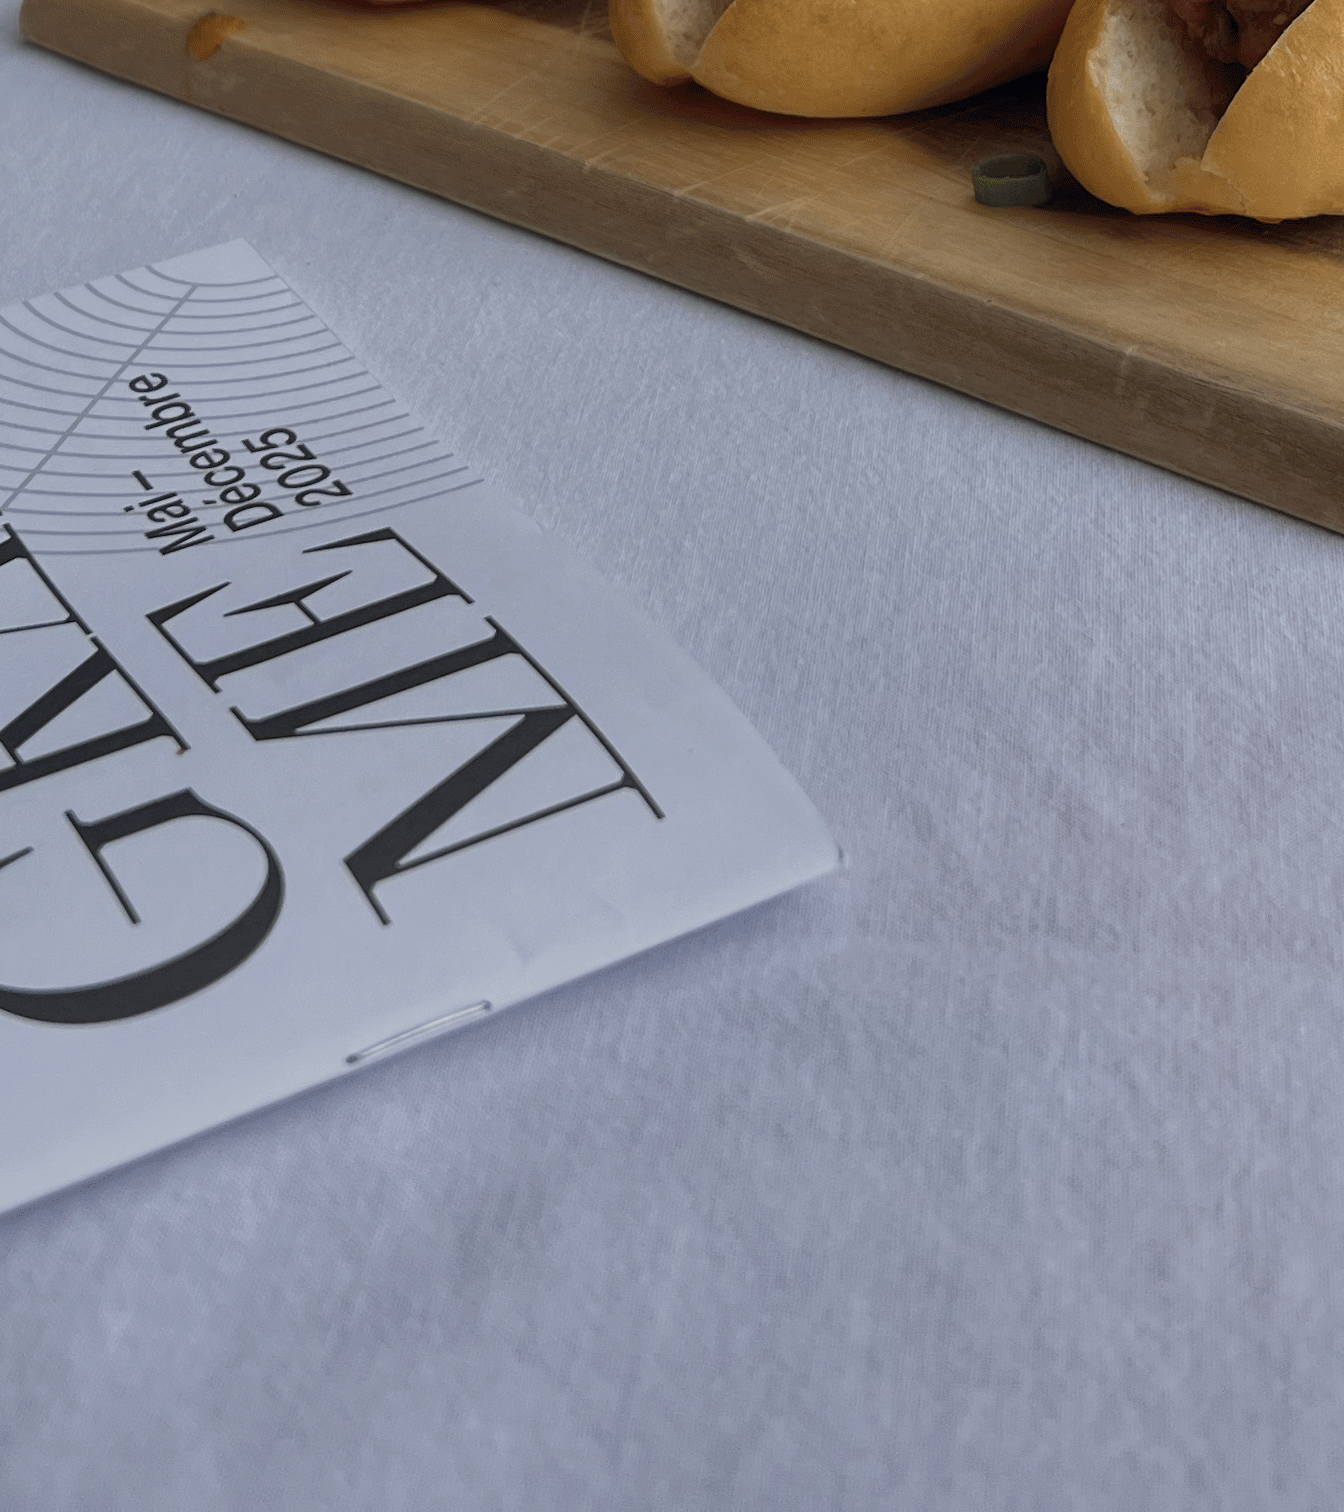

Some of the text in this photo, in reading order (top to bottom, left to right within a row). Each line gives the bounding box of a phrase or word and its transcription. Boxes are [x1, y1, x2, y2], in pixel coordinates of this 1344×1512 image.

[129, 372, 284, 532] Décembre
[241, 428, 353, 506] 2025
[146, 526, 665, 925] ME
